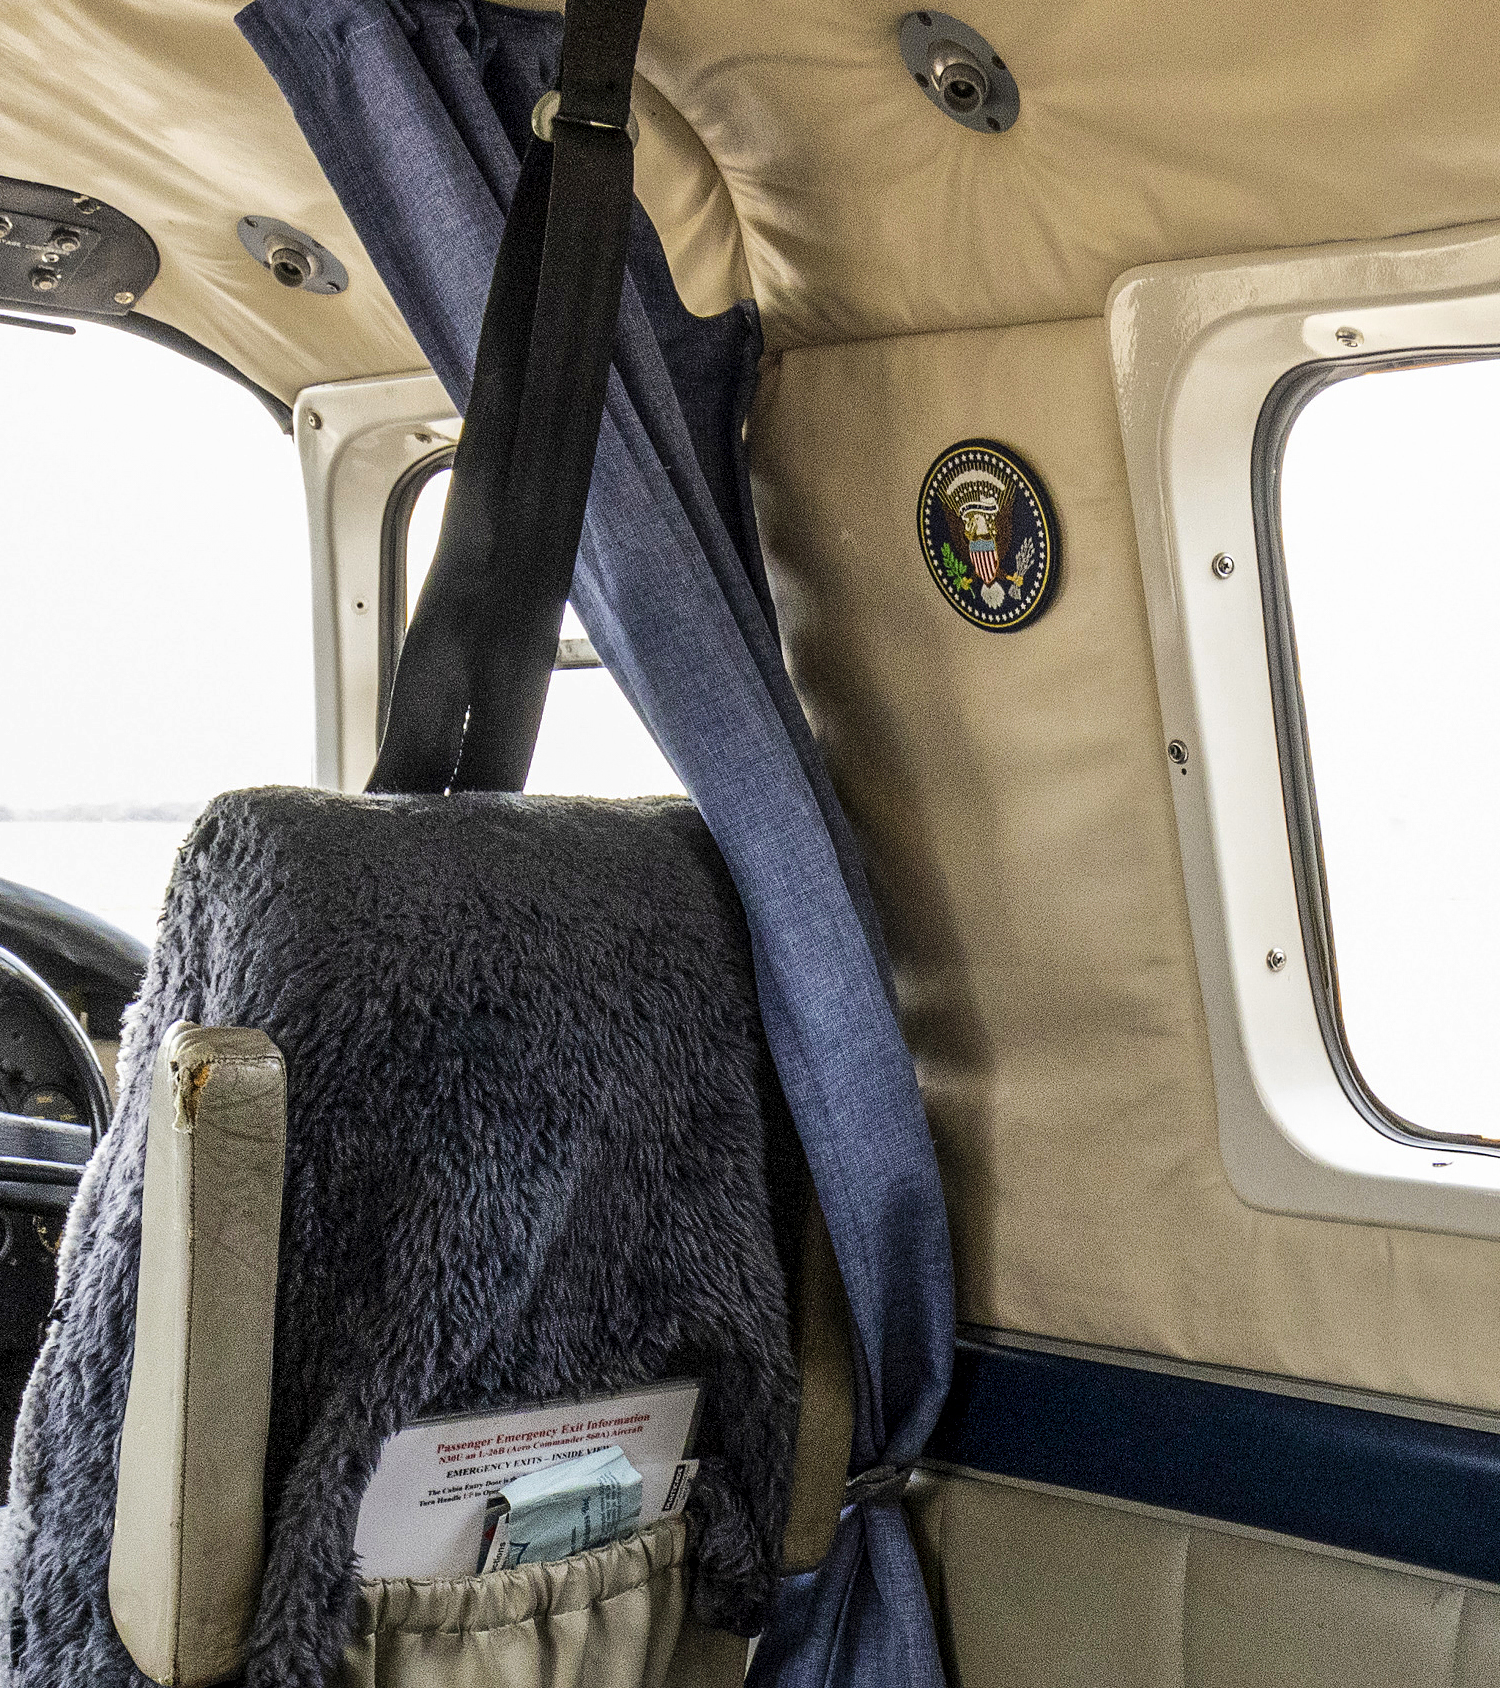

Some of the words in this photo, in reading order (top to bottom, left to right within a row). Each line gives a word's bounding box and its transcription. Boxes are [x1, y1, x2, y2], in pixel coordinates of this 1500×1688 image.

[436, 1437, 494, 1454] Passenger
[495, 1427, 558, 1444] Emergency
[561, 1422, 584, 1435] Exit
[586, 1412, 651, 1431] Information
[532, 1435, 584, 1449] Commander
[611, 1424, 644, 1437] Aircraft
[446, 1460, 512, 1479] EMERGENCY
[513, 1455, 543, 1468] EXITS
[552, 1449, 584, 1462] INSIDE
